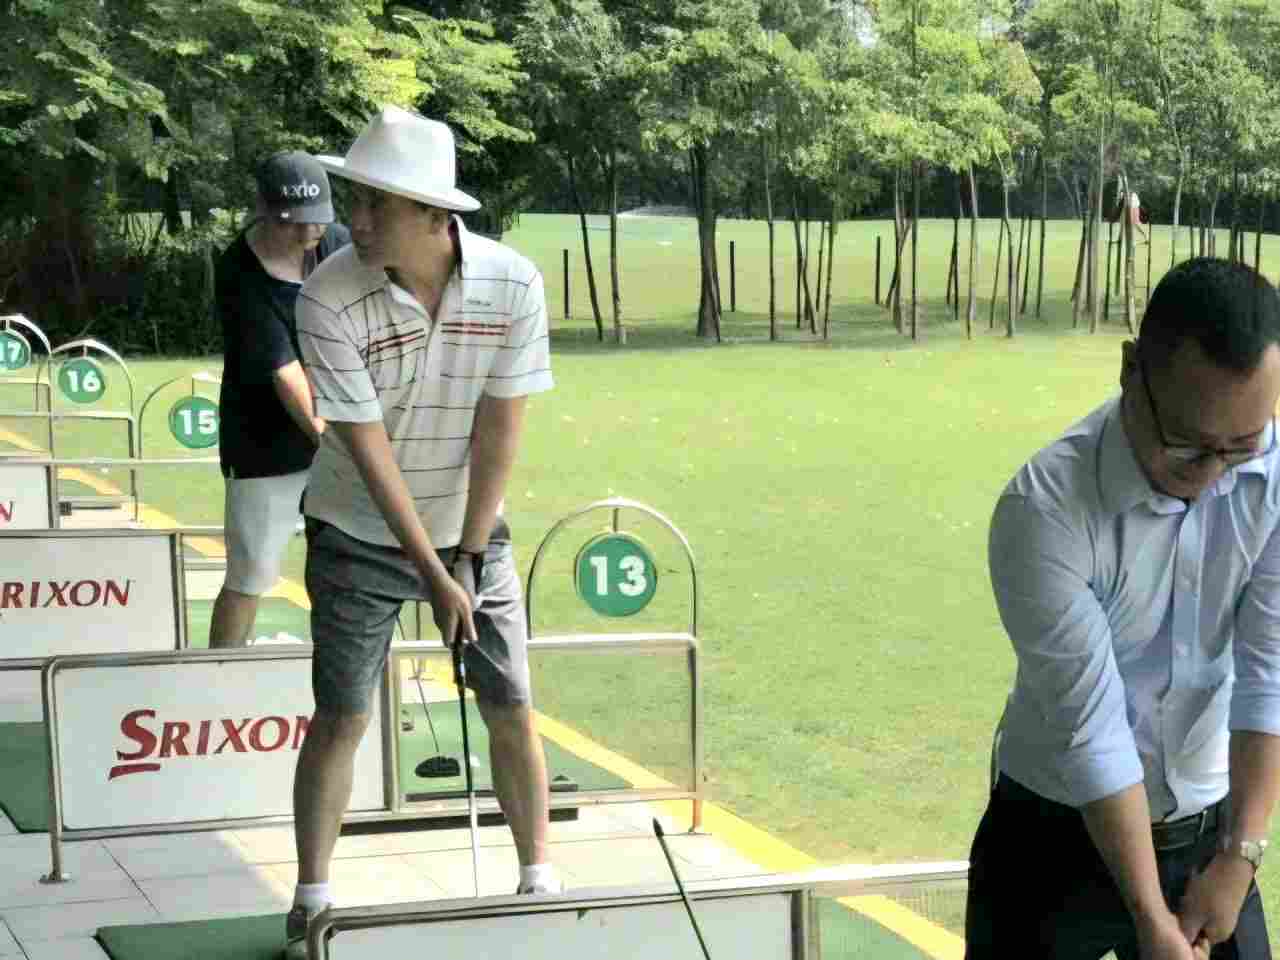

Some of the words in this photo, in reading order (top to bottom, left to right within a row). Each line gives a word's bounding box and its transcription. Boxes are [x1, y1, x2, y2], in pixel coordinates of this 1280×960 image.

[67, 370, 101, 392] 16
[178, 409, 217, 435] 15
[590, 555, 647, 596] 13
[0, 578, 130, 608] RIXON
